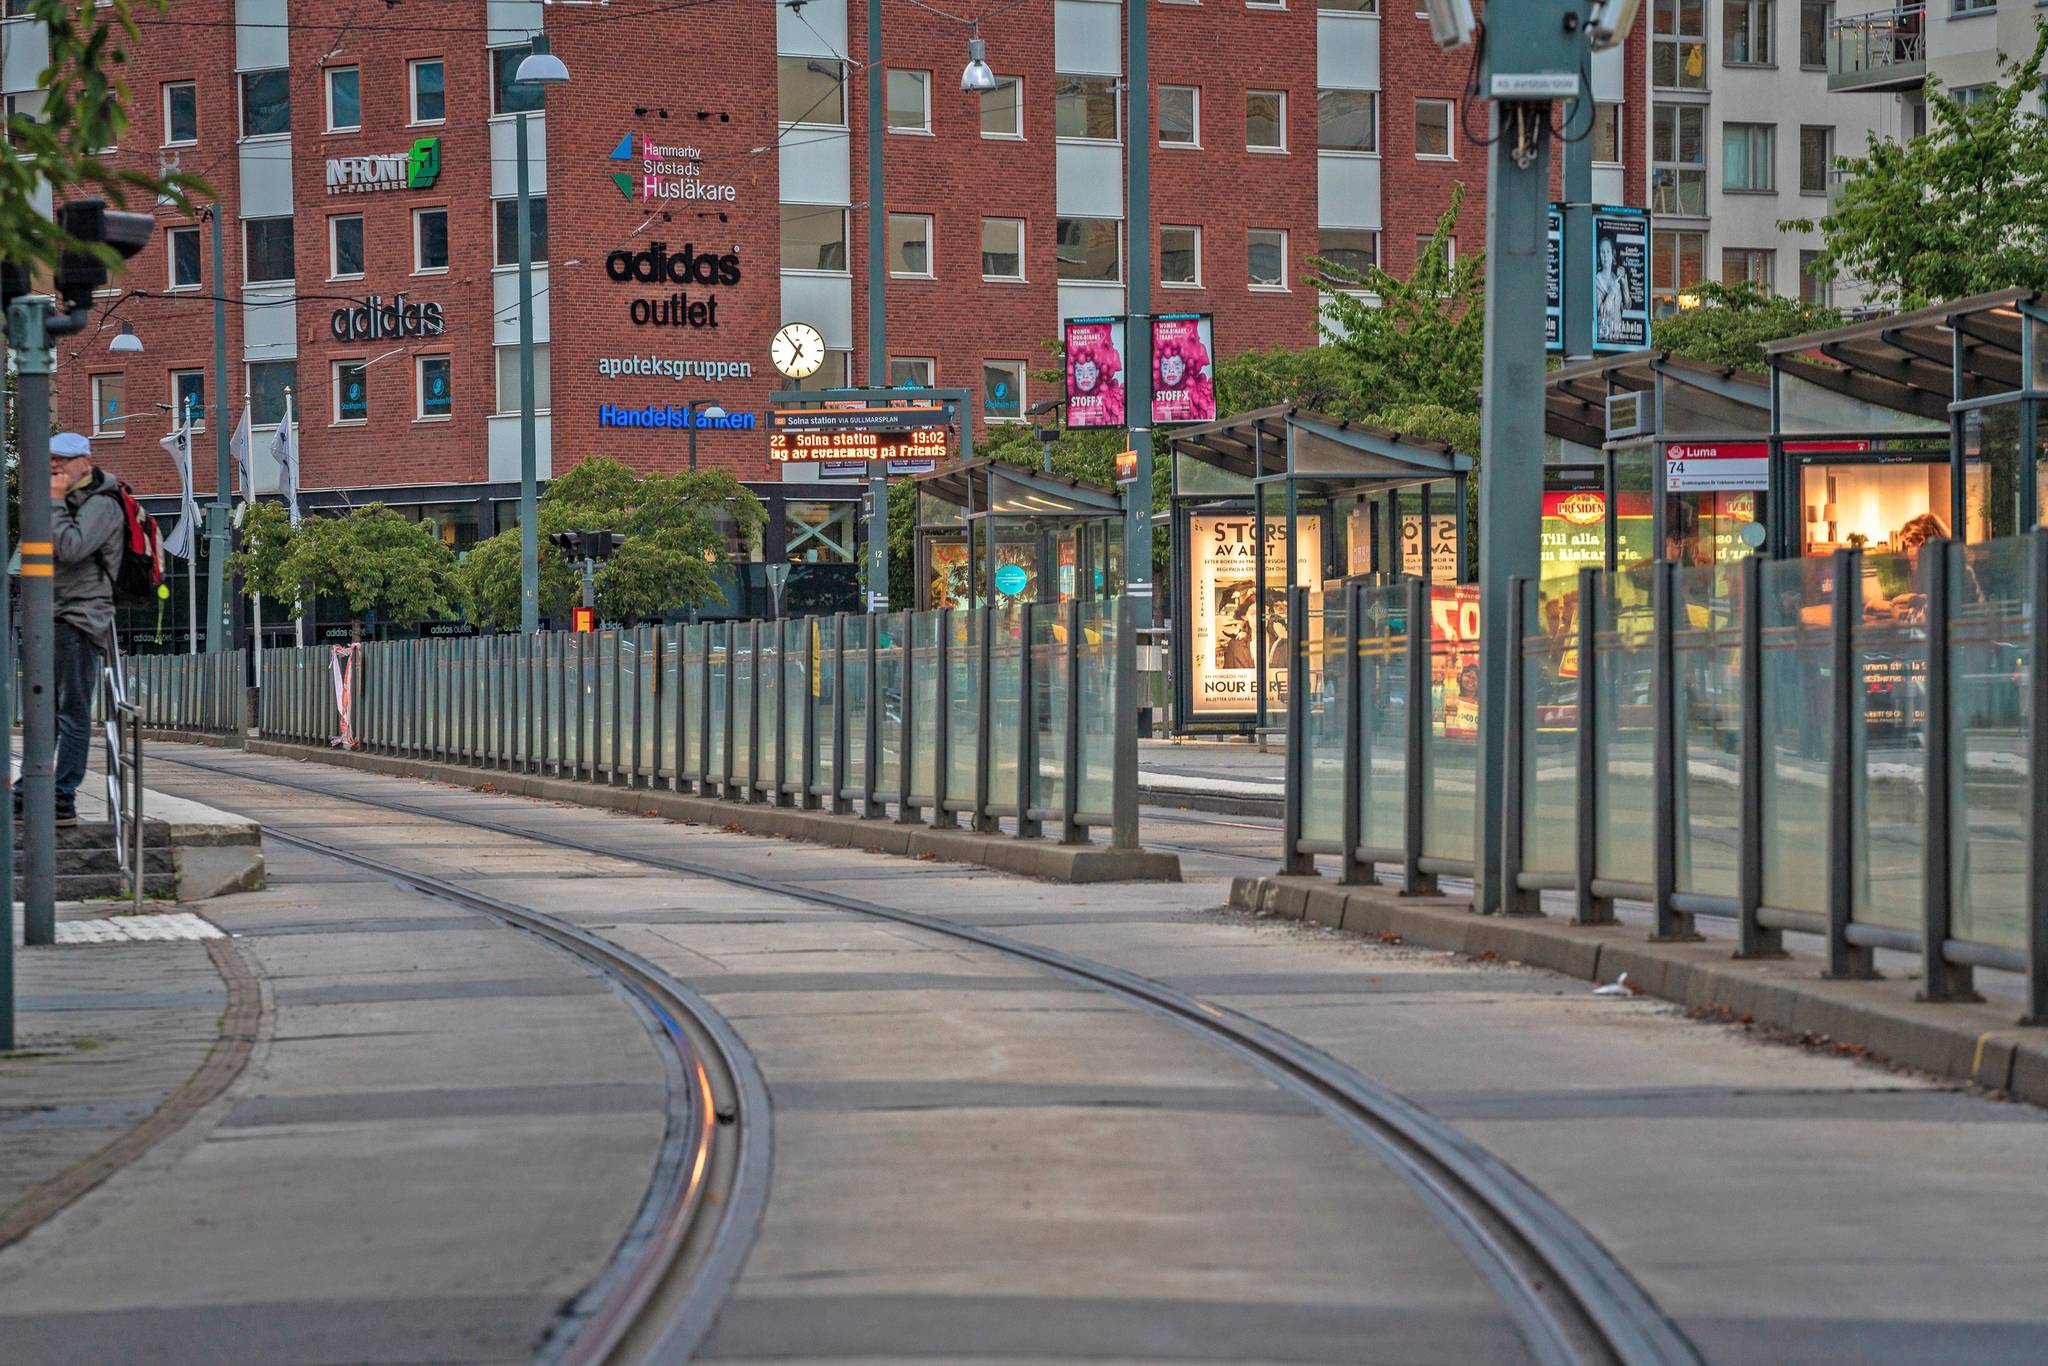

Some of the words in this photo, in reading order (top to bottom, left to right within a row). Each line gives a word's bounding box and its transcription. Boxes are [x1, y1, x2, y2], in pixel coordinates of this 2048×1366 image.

[644, 143, 701, 158] Hammarby
[326, 154, 408, 187] INFRONT
[643, 160, 700, 176] Sjöstads
[327, 181, 408, 195] IT-PARTNER
[644, 177, 736, 201] Husläkare
[606, 242, 741, 286] adidas
[630, 292, 718, 328] outlet
[331, 295, 446, 342] adidas
[599, 355, 752, 381] apoteksgruppen
[788, 416, 809, 425] Solna
[810, 415, 836, 425] station
[770, 434, 786, 447] 22
[797, 433, 829, 446] Solna
[834, 433, 876, 445] station
[912, 432, 945, 443] 19:02
[792, 448, 808, 459] av
[811, 446, 877, 460] evenemang
[880, 445, 897, 459] på
[900, 445, 946, 457] Friends
[1687, 447, 1717, 457] Luma
[1668, 461, 1685, 474] 74
[1558, 502, 1606, 514] PRÉSIDEN
[1541, 533, 1567, 546] Till
[1571, 533, 1600, 546] alla
[1215, 545, 1233, 556] AV
[1238, 545, 1275, 556] ALT
[1617, 548, 1642, 560] rie.
[326, 628, 348, 637] adidas
[430, 624, 453, 634] adidas
[1205, 681, 1246, 693] NOUR
